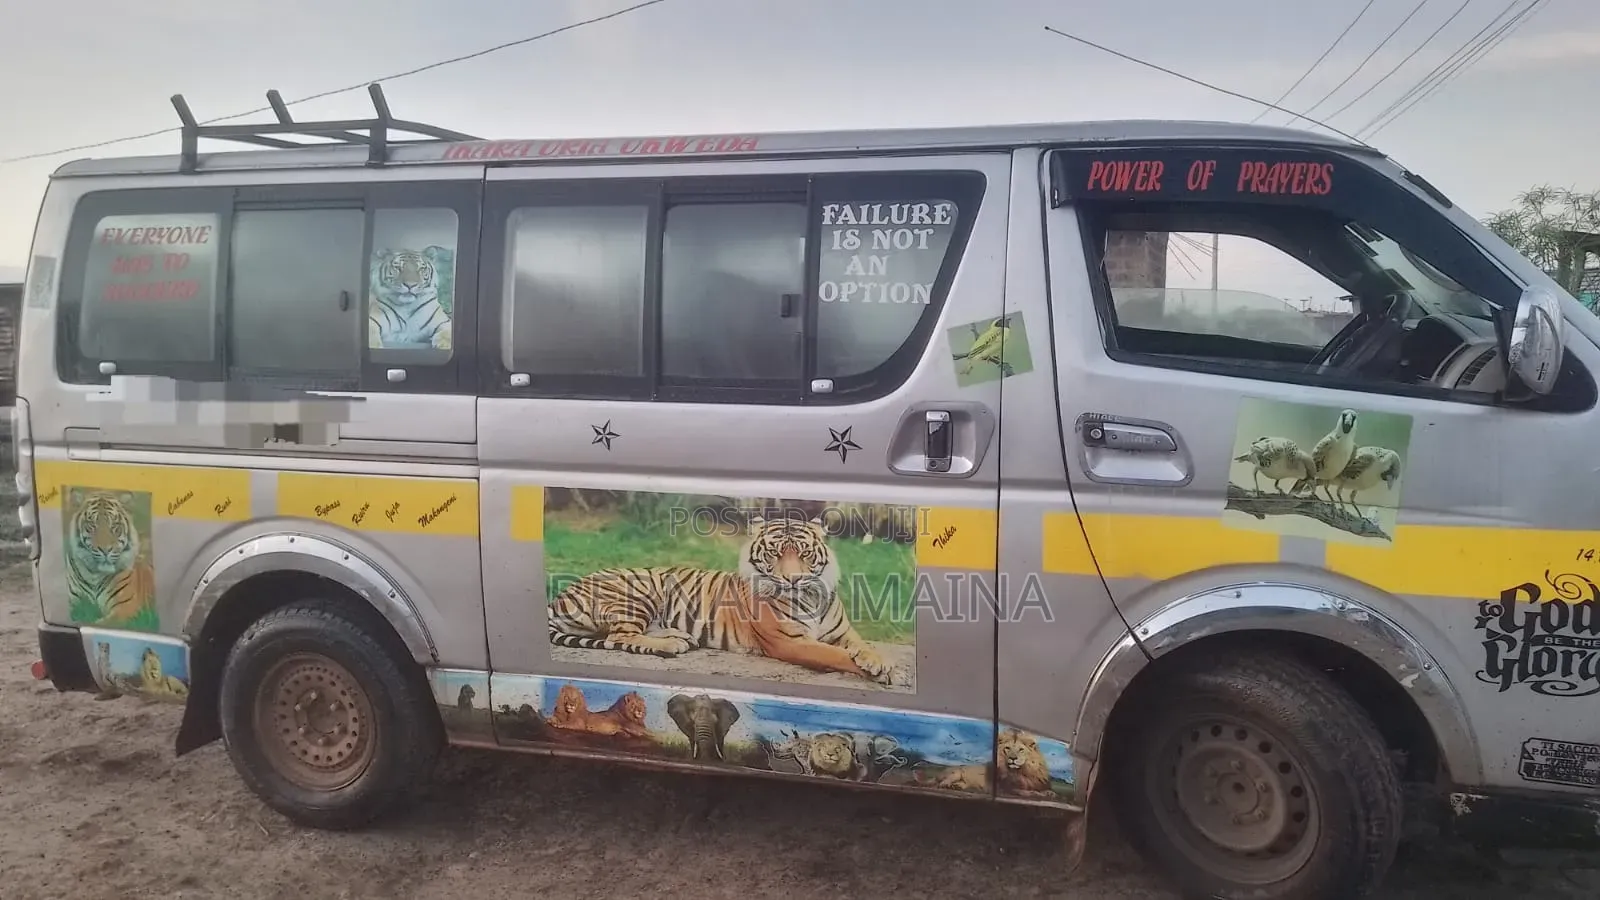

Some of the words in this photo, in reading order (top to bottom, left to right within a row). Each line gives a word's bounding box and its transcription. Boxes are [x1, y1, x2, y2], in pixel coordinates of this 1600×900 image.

[1087, 160, 1164, 191] POWER
[1187, 160, 1216, 191] OF
[1236, 161, 1334, 195] PRAYERS
[822, 203, 952, 225] FAILURE
[101, 225, 212, 246] EVERYONE
[831, 229, 861, 250] IS
[871, 229, 934, 250] NOT
[844, 255, 889, 276] AN
[818, 281, 933, 305] OPTION
[932, 525, 957, 549] Thika
[1544, 637, 1563, 645] BE
